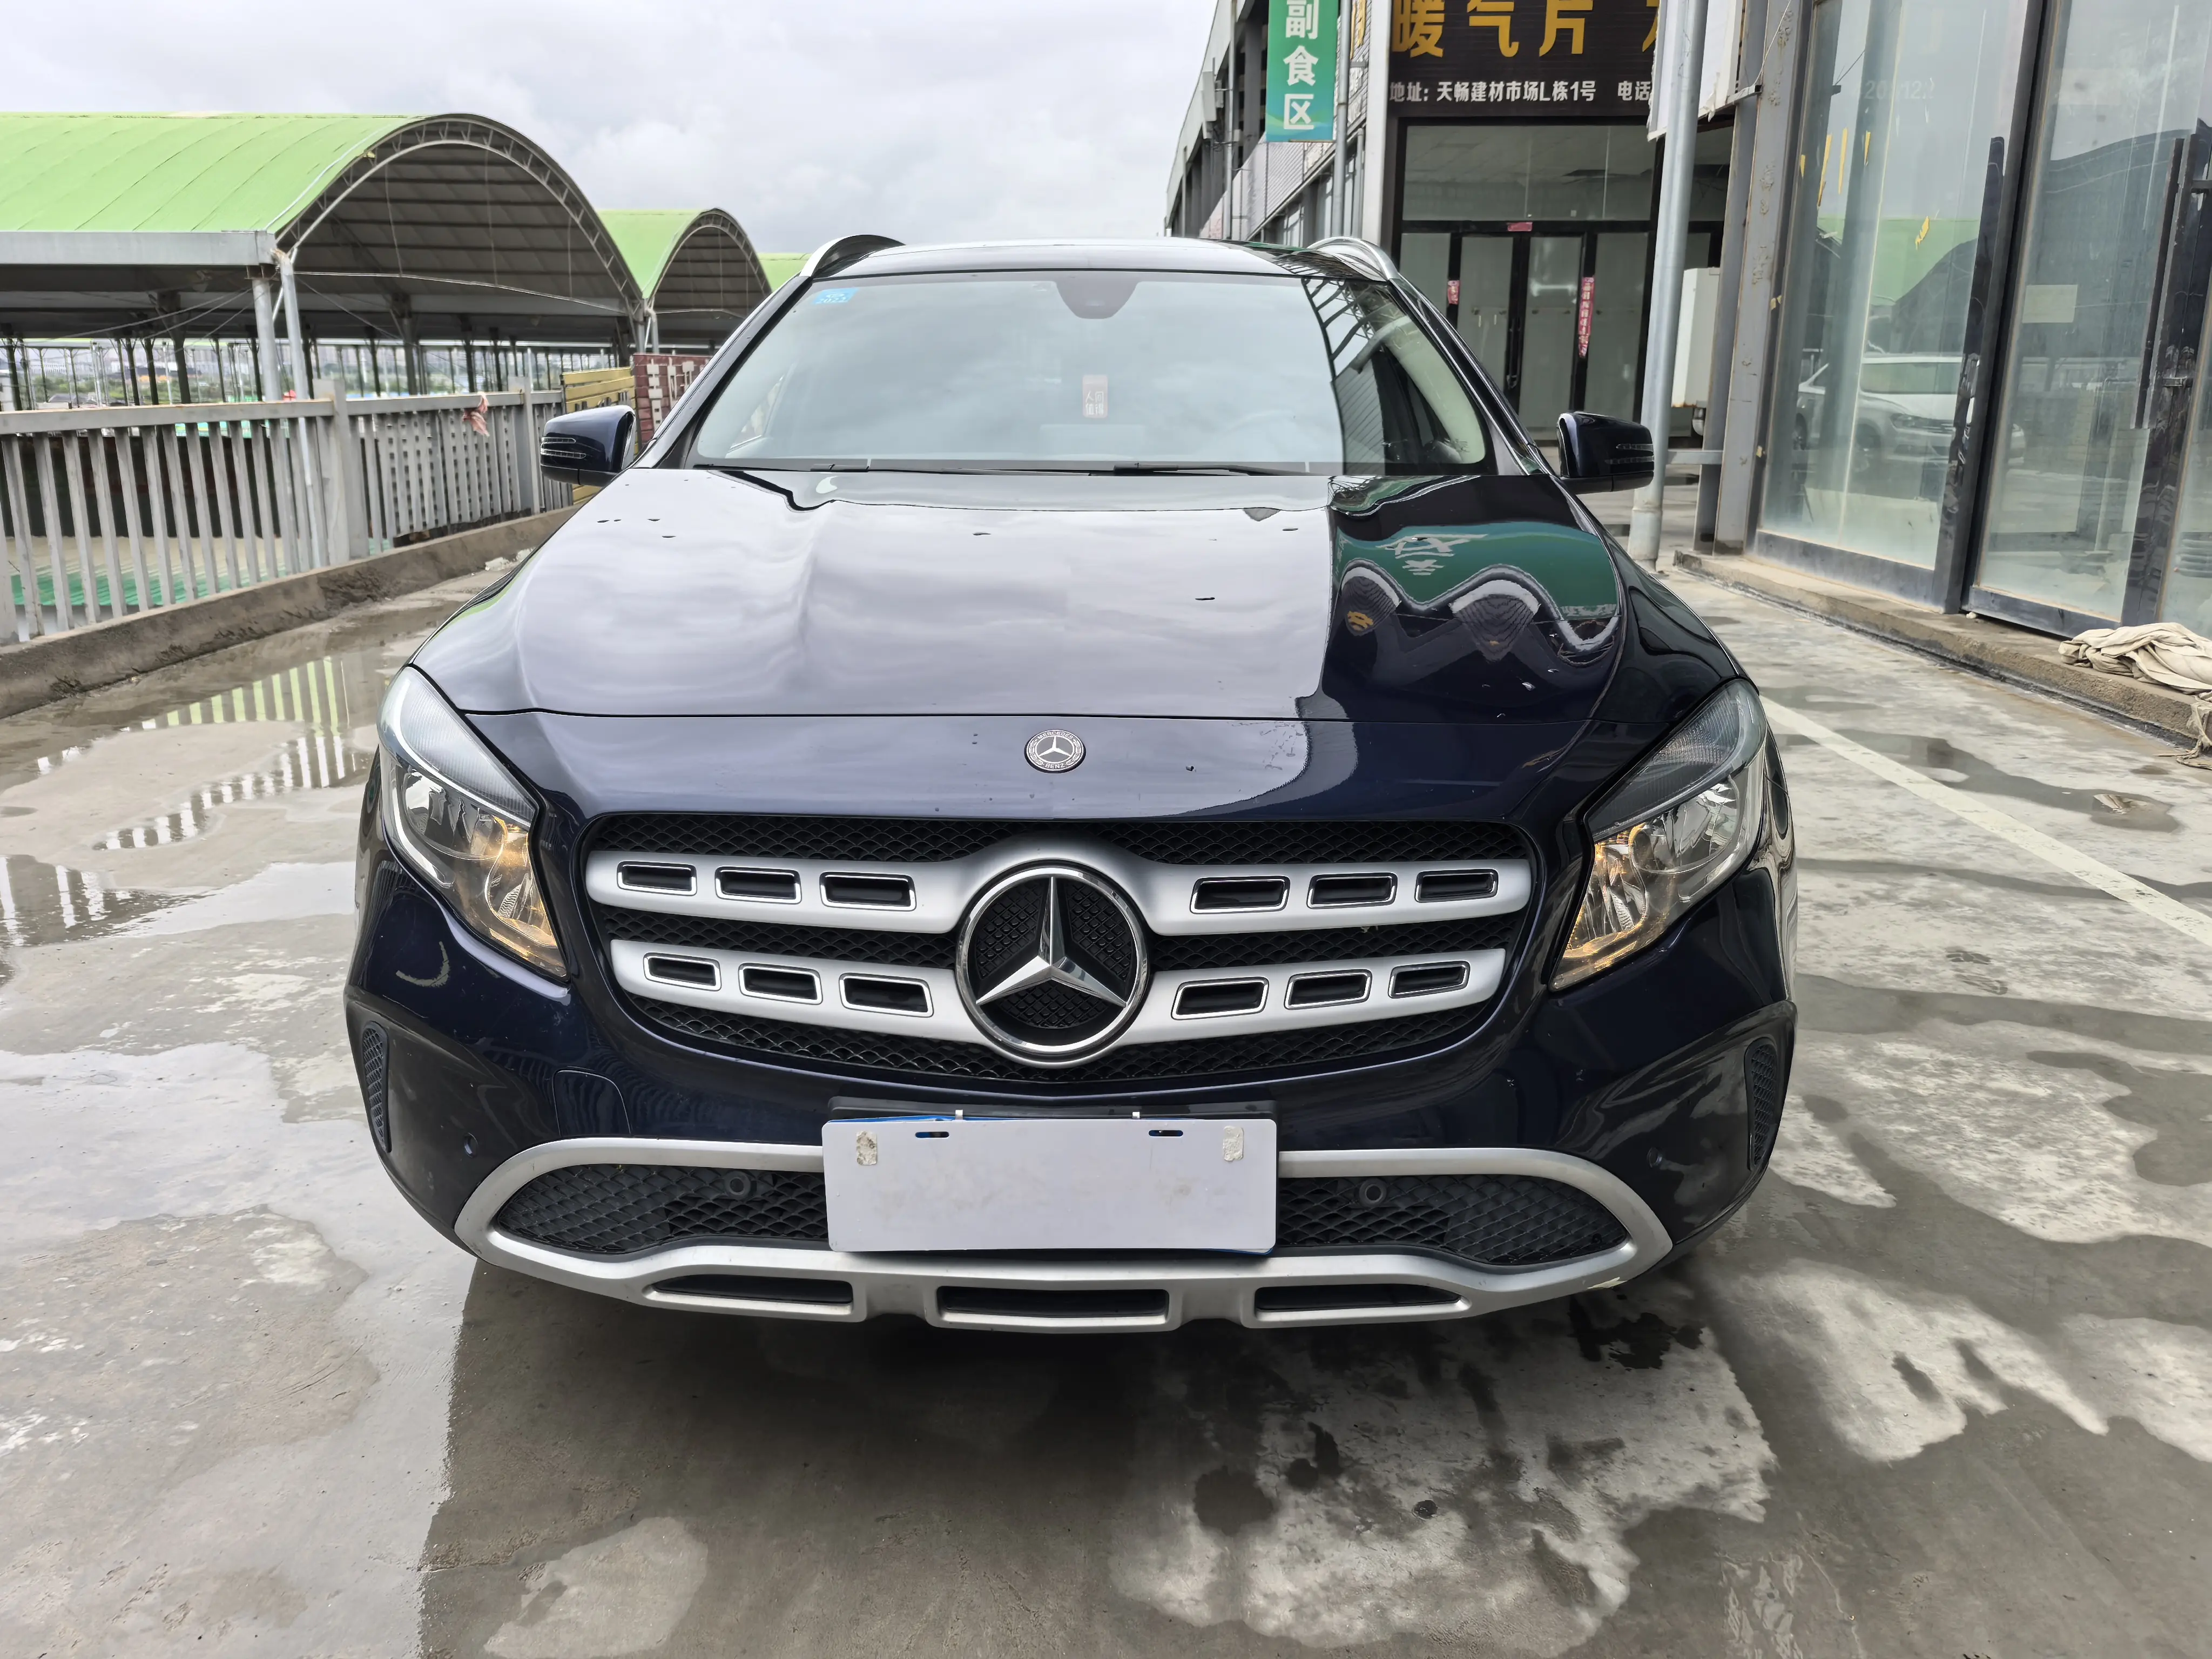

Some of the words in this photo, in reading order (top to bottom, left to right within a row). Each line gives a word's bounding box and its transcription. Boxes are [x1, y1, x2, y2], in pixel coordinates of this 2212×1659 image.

[1392, 0, 1660, 57] 暖气片
[1283, 0, 1319, 130] 副食区
[1617, 81, 1651, 101] 电话
[1037, 731, 1074, 739] MERCEDES
